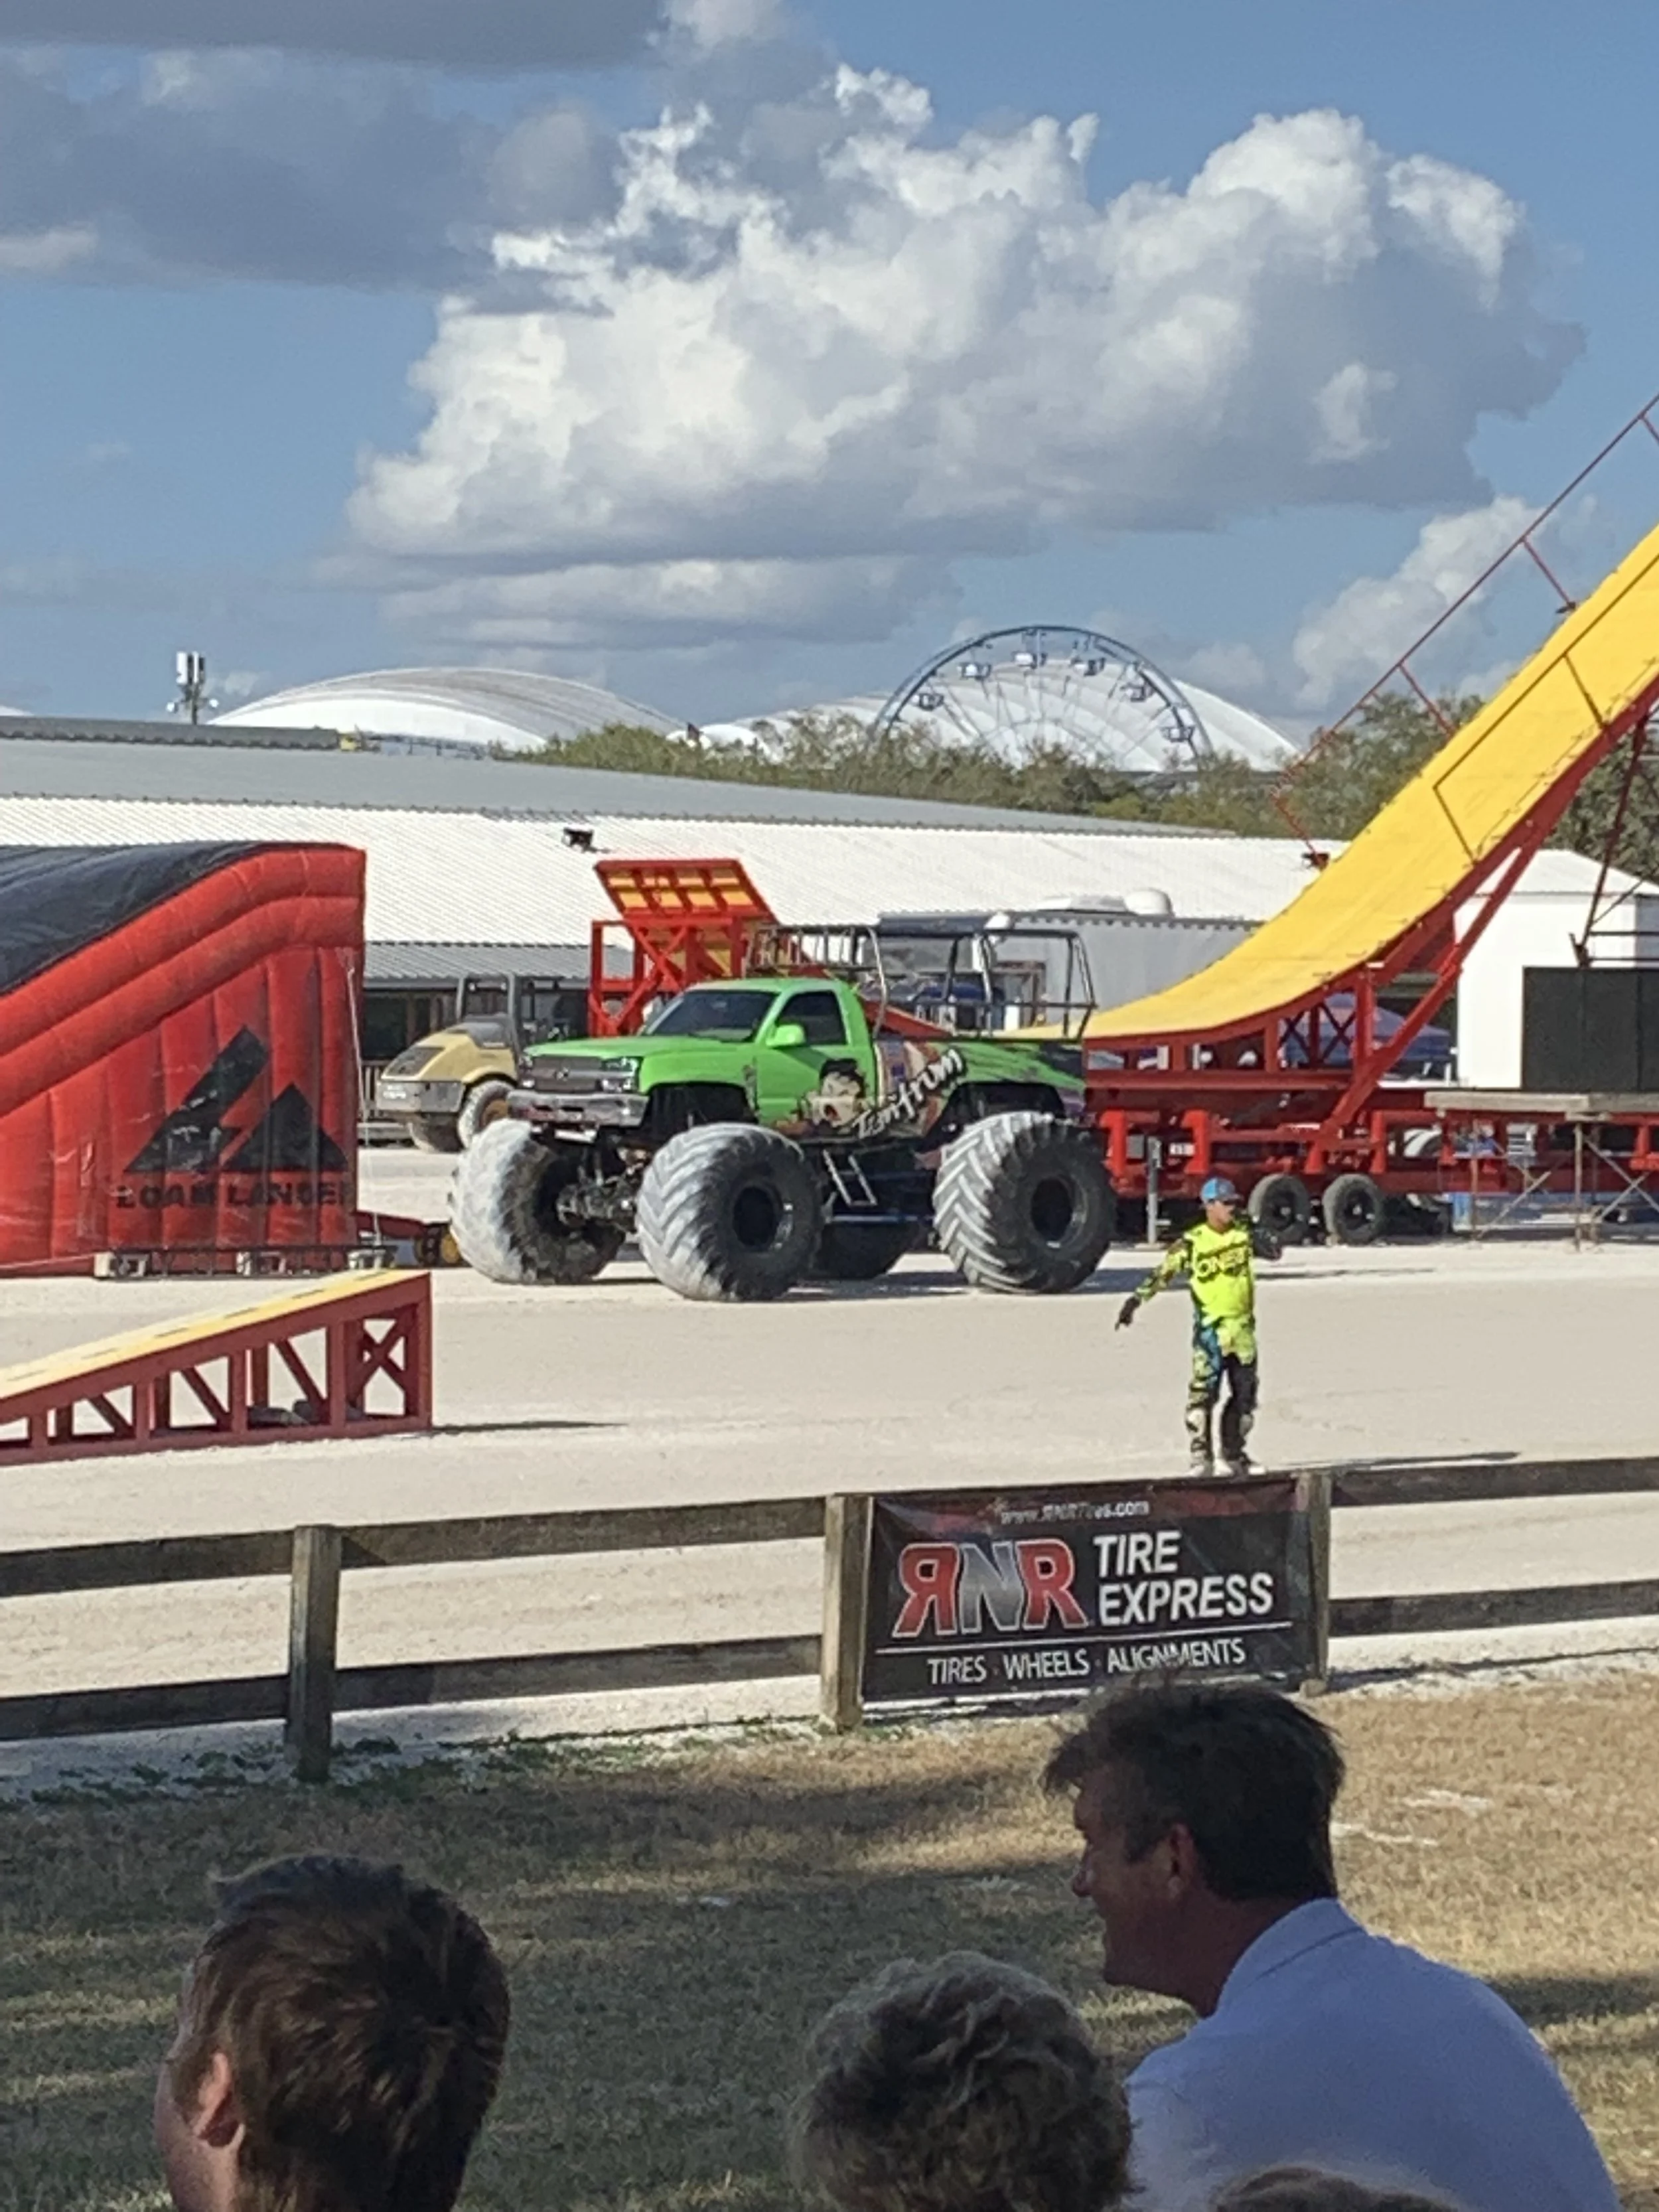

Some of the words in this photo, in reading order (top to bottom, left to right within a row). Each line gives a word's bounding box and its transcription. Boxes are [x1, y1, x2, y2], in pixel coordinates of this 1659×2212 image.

[1093, 1530, 1181, 1578] TIRE
[1098, 1572, 1274, 1627] EXPRESS
[928, 1656, 987, 1685] TIRES
[1003, 1648, 1090, 1680] WHEELS
[1107, 1638, 1246, 1674] ALIGNMENTS
